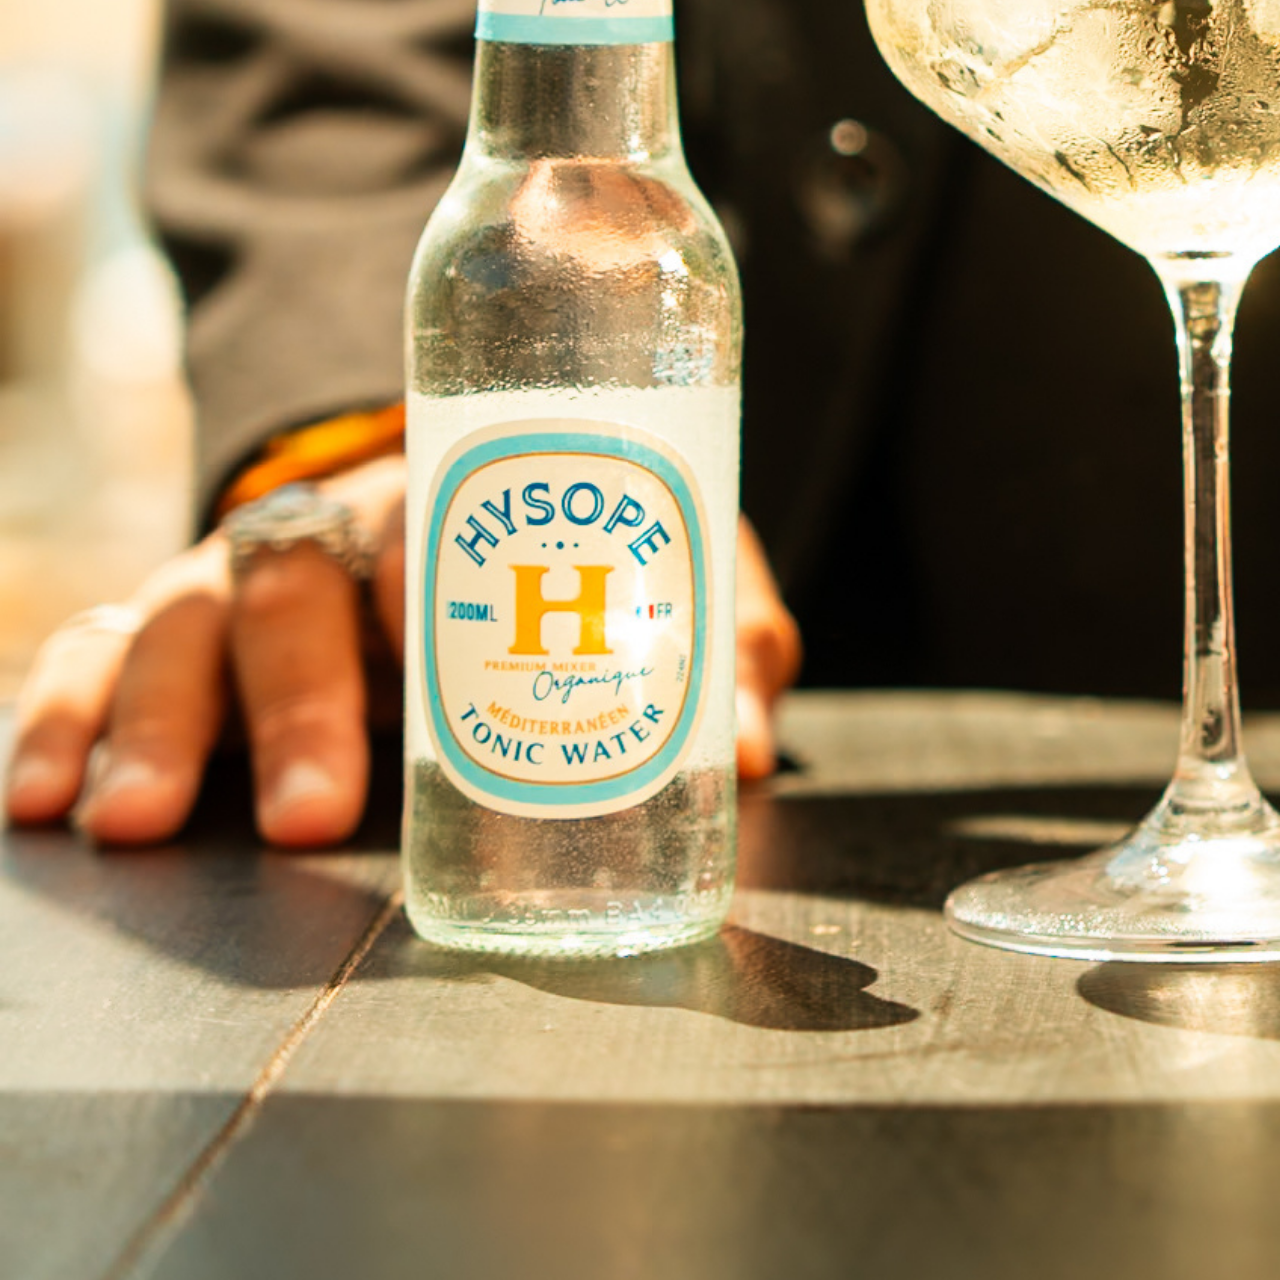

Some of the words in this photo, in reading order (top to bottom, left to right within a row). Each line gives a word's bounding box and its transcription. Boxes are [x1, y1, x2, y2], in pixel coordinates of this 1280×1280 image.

[454, 482, 671, 567] HYSOPE
[449, 601, 498, 622] 200ML
[508, 564, 615, 656] H
[657, 603, 673, 619] FR
[484, 660, 546, 672] PREMIUM
[552, 662, 597, 672] MIXER
[532, 666, 654, 704] Organique
[460, 703, 545, 766] TONIC
[561, 703, 665, 766] WATER
[486, 700, 631, 736] MÉDITERRANÉEN
